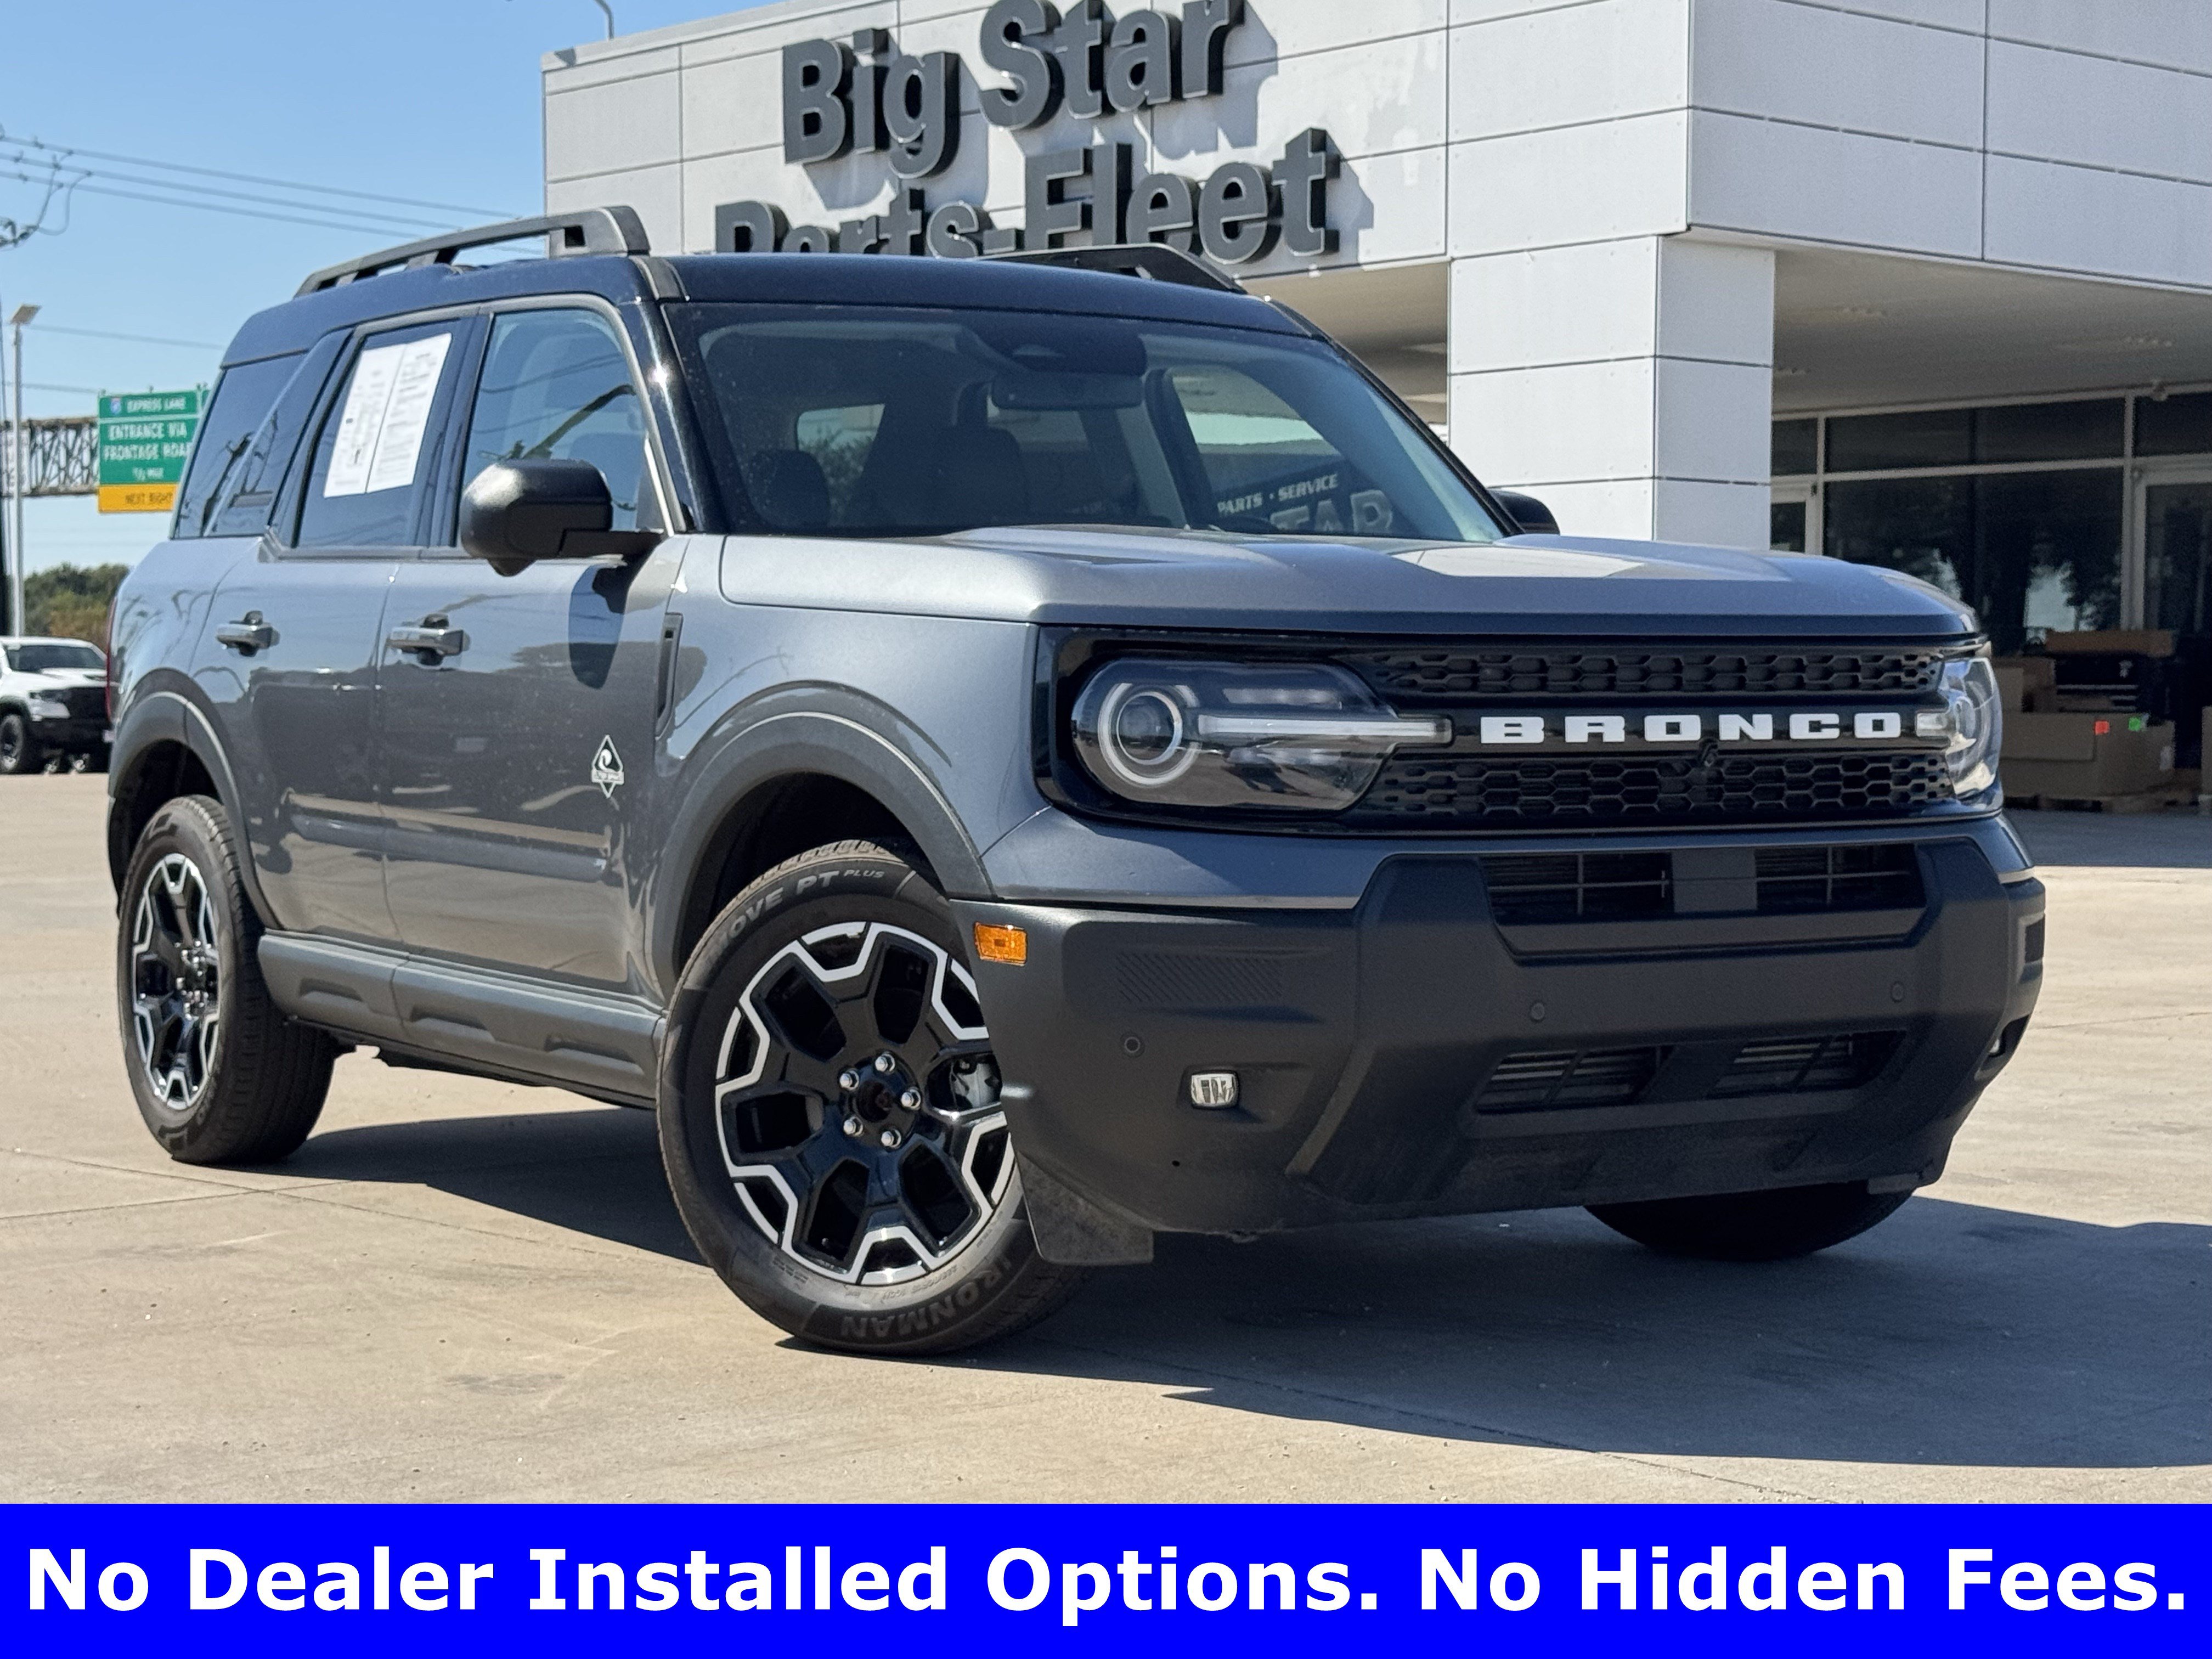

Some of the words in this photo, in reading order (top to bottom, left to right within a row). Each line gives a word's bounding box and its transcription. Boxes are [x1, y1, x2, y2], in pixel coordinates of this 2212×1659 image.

[783, 29, 960, 179] Big
[980, 0, 1244, 131] Star
[109, 422, 165, 441] ENTRANCE
[168, 421, 187, 438] VIA
[104, 443, 159, 461] FRONTAGE
[1217, 493, 1262, 515] PARTS
[1278, 472, 1339, 501] SERVICE
[1480, 712, 1901, 744] BRONCO
[795, 870, 839, 895] PT
[843, 868, 885, 879] PLUS
